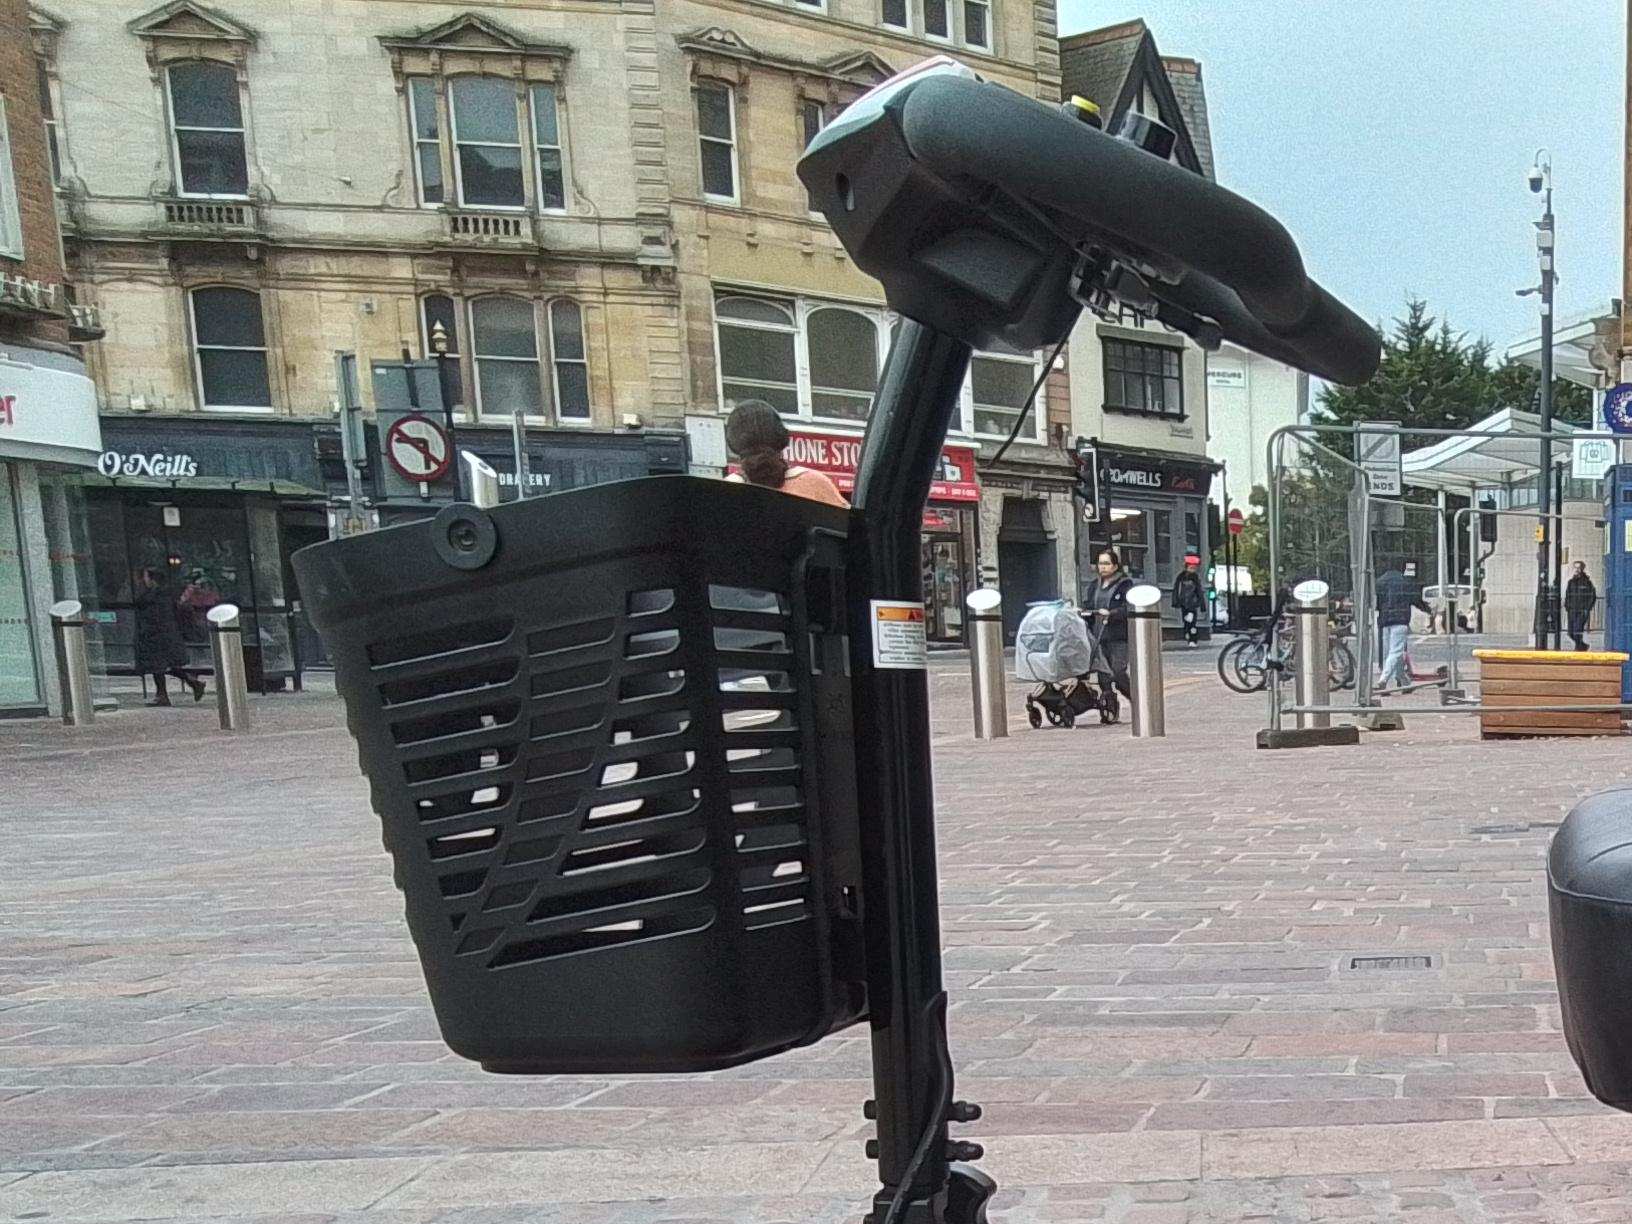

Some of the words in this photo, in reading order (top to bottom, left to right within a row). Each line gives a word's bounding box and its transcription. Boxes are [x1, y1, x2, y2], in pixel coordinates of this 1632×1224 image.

[98, 451, 198, 477] O'Neill's
[782, 436, 829, 465] HONE
[830, 441, 863, 467] STO
[498, 472, 551, 486] DRAERY
